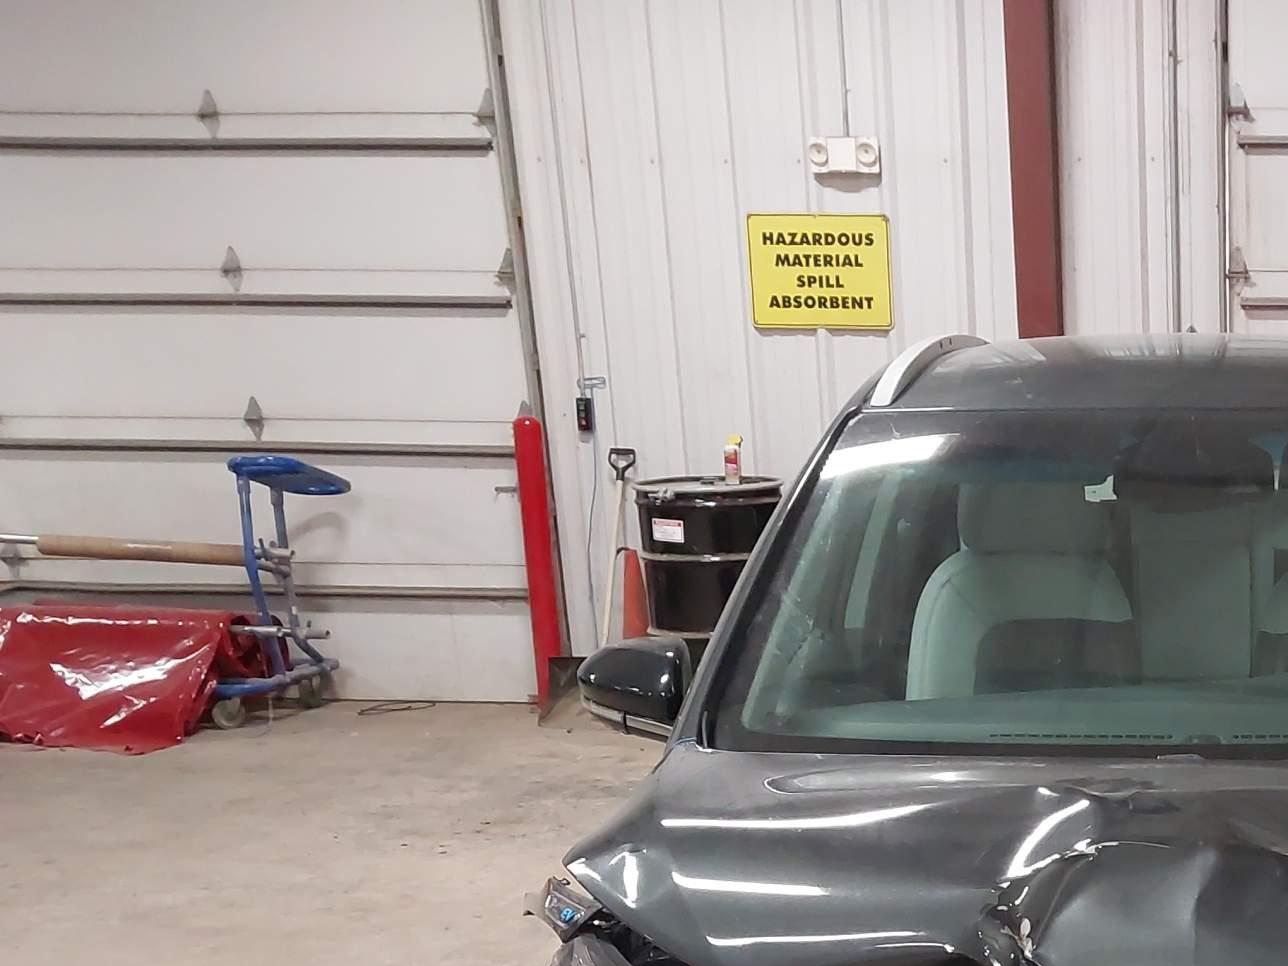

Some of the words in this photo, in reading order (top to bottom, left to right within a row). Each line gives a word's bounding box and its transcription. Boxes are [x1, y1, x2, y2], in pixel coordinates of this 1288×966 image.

[762, 231, 874, 247] HAZARDOUS
[775, 253, 864, 268] MATERIAL
[796, 274, 845, 289] SPILL
[768, 295, 874, 310] ABSORBENT
